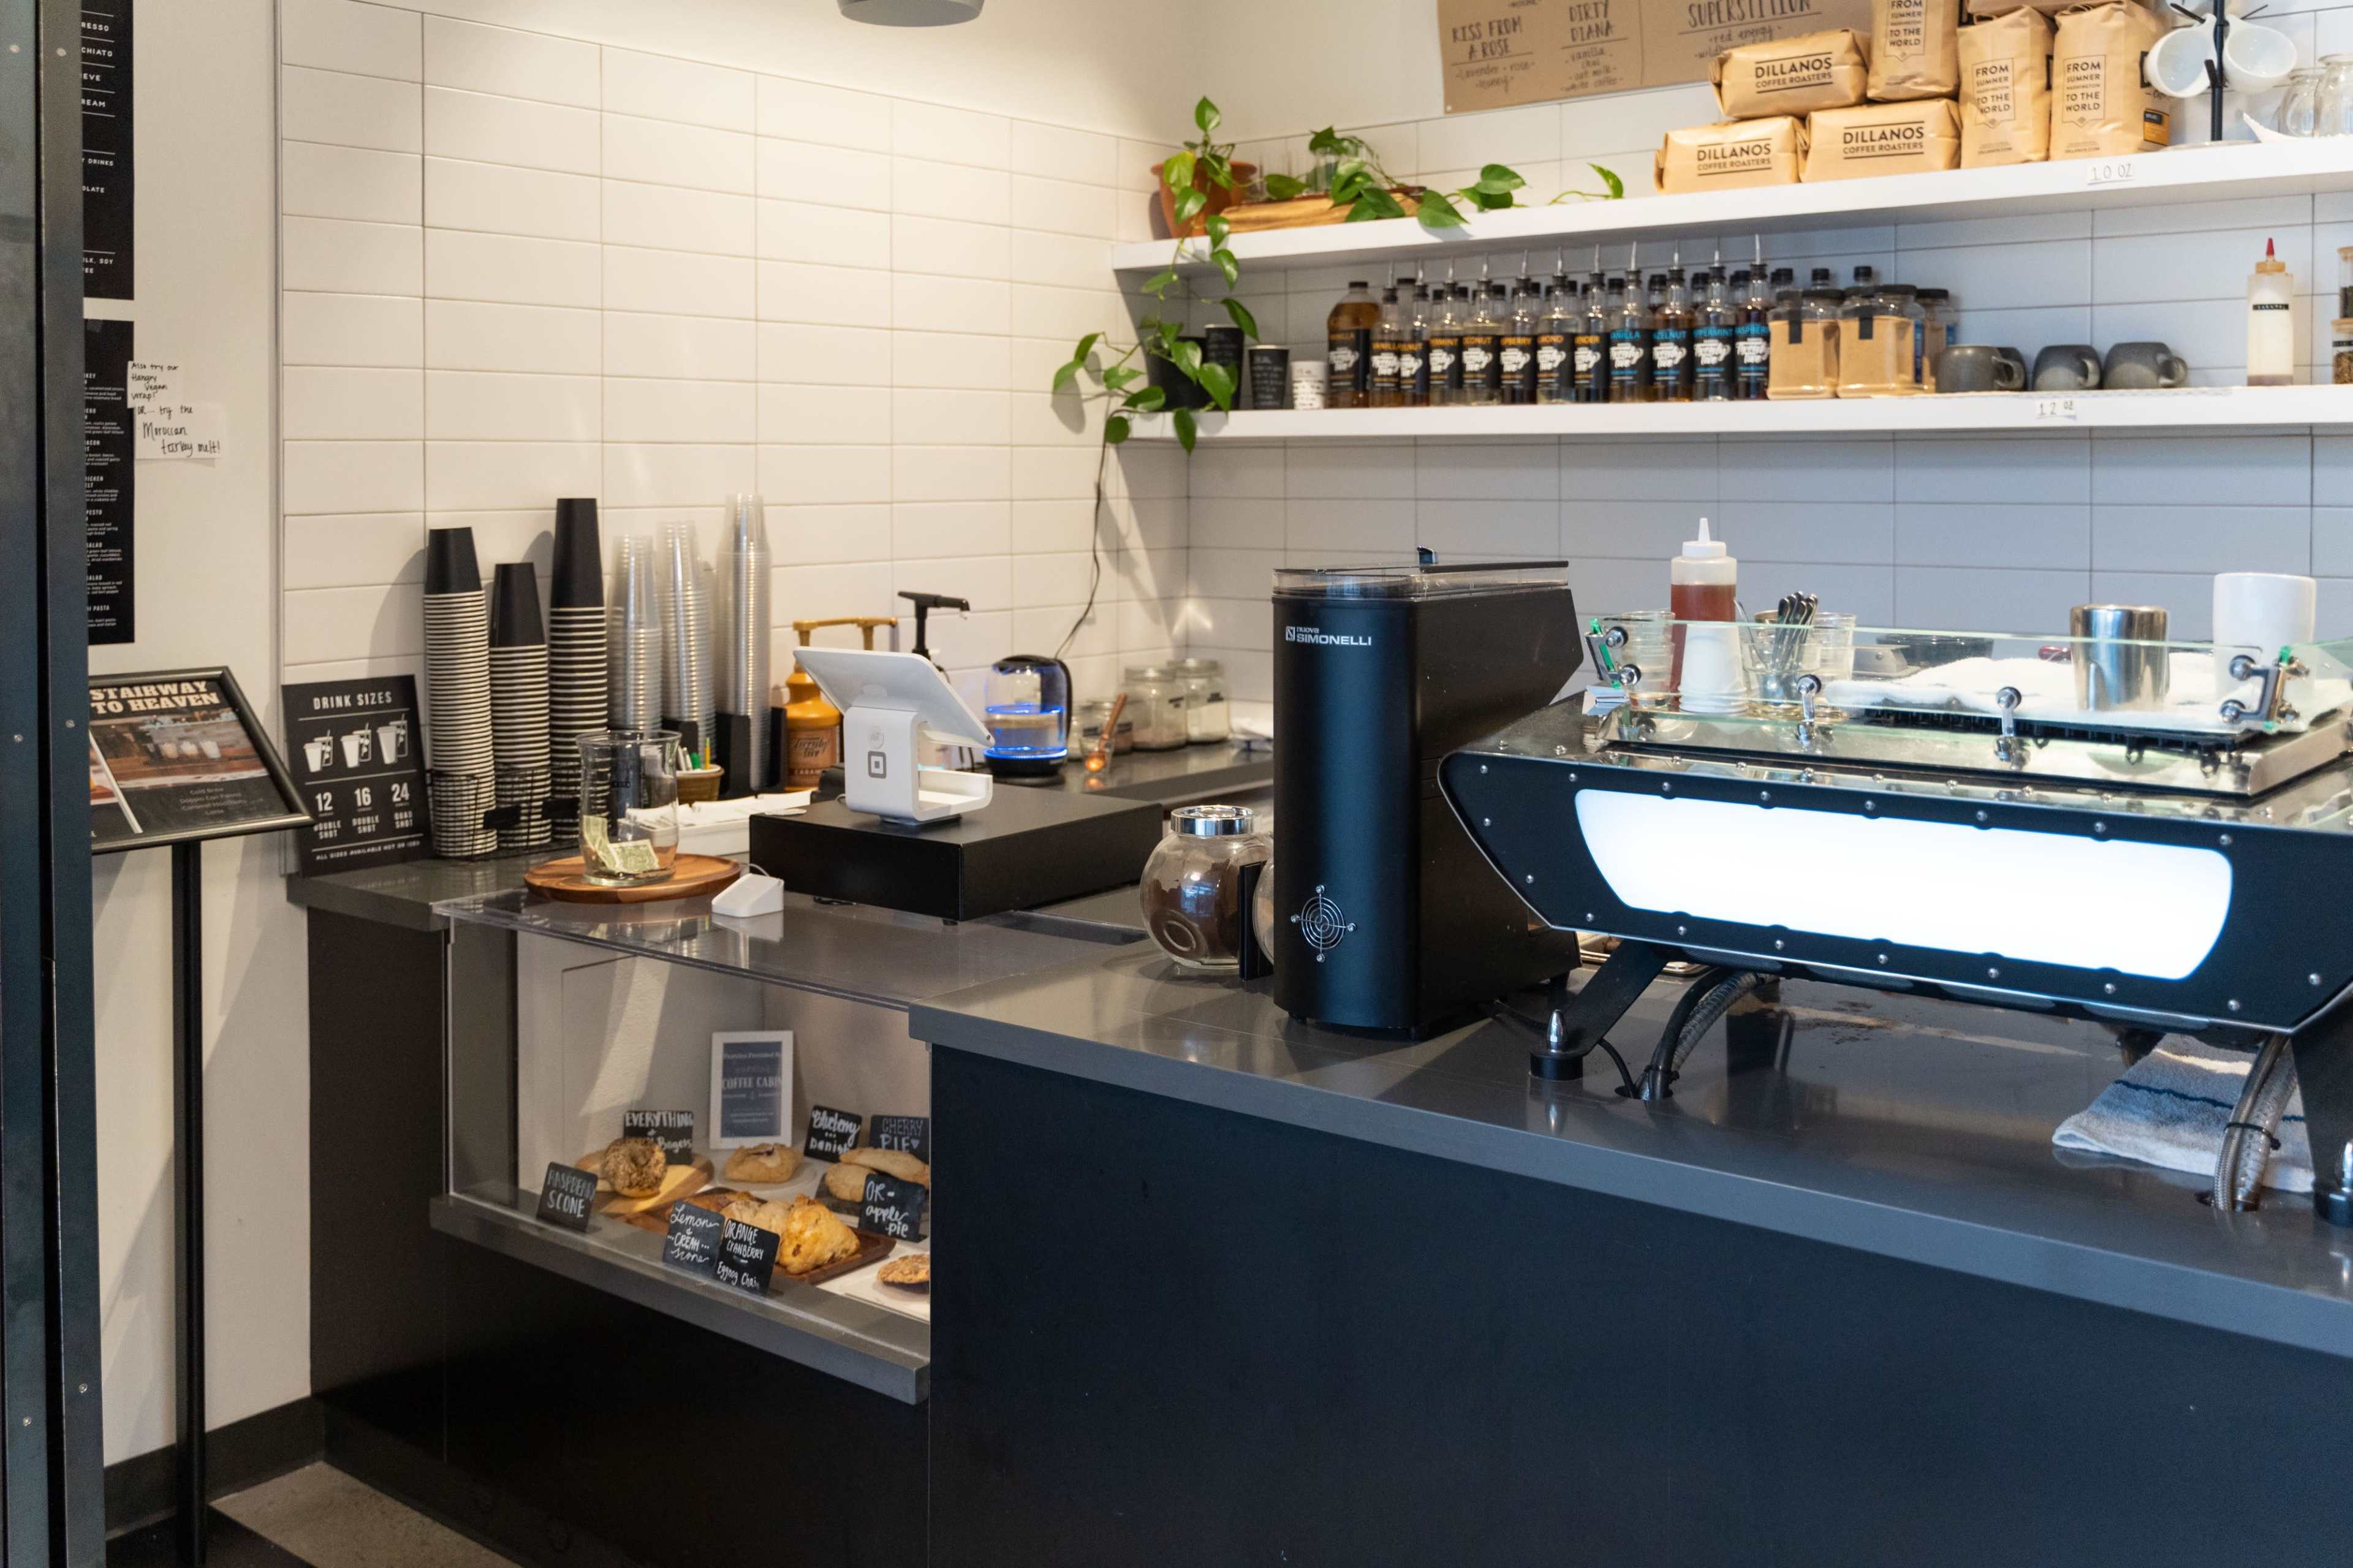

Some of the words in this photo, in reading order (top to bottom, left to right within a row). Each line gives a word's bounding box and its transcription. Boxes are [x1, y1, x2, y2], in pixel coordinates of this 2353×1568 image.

[1569, 0, 1609, 22] DIRTY
[1891, 0, 1922, 9] FROM
[1452, 22, 1482, 43] KISS
[1489, 15, 1522, 37] FROM
[1571, 20, 1615, 42] DIANA
[1469, 44, 1477, 61] A
[1481, 38, 1511, 58] ROSE
[1755, 58, 1832, 78] DILLANOS
[1976, 65, 2009, 77] FROM
[2066, 62, 2101, 73] FROM
[1756, 77, 1786, 88] COFFEE
[1789, 72, 1832, 83] ROASTERS
[1976, 77, 2009, 87] SUMNER
[2066, 74, 2101, 83] SUMNER
[2066, 103, 2101, 112] WORLD
[1843, 127, 1924, 144] DILLANOS
[1697, 143, 1771, 161] DILLANOS
[1843, 144, 1876, 154] COFFEE
[1878, 142, 1923, 152] ROASTERS
[1697, 161, 1728, 171] COFFEE
[1729, 157, 1771, 168] ROASTERS
[159, 405, 172, 420] try
[180, 404, 194, 414] the
[1296, 634, 1372, 645] SIMONELLI
[89, 681, 208, 701] STAIRWAY
[313, 695, 352, 711] DRINK
[357, 691, 393, 706] SIZES
[91, 702, 125, 714] TO
[127, 692, 221, 711] HEAVEN
[315, 792, 334, 812] 12
[354, 787, 372, 807] 16
[391, 782, 410, 803] 24
[882, 1117, 923, 1137] CHERRY
[879, 1133, 911, 1153] PIE
[547, 1189, 585, 1218] SCONE
[670, 1204, 720, 1228] Lemon
[725, 1220, 759, 1245] ORANGE
[885, 1221, 909, 1238] pie
[717, 1260, 739, 1286] Eggnog
